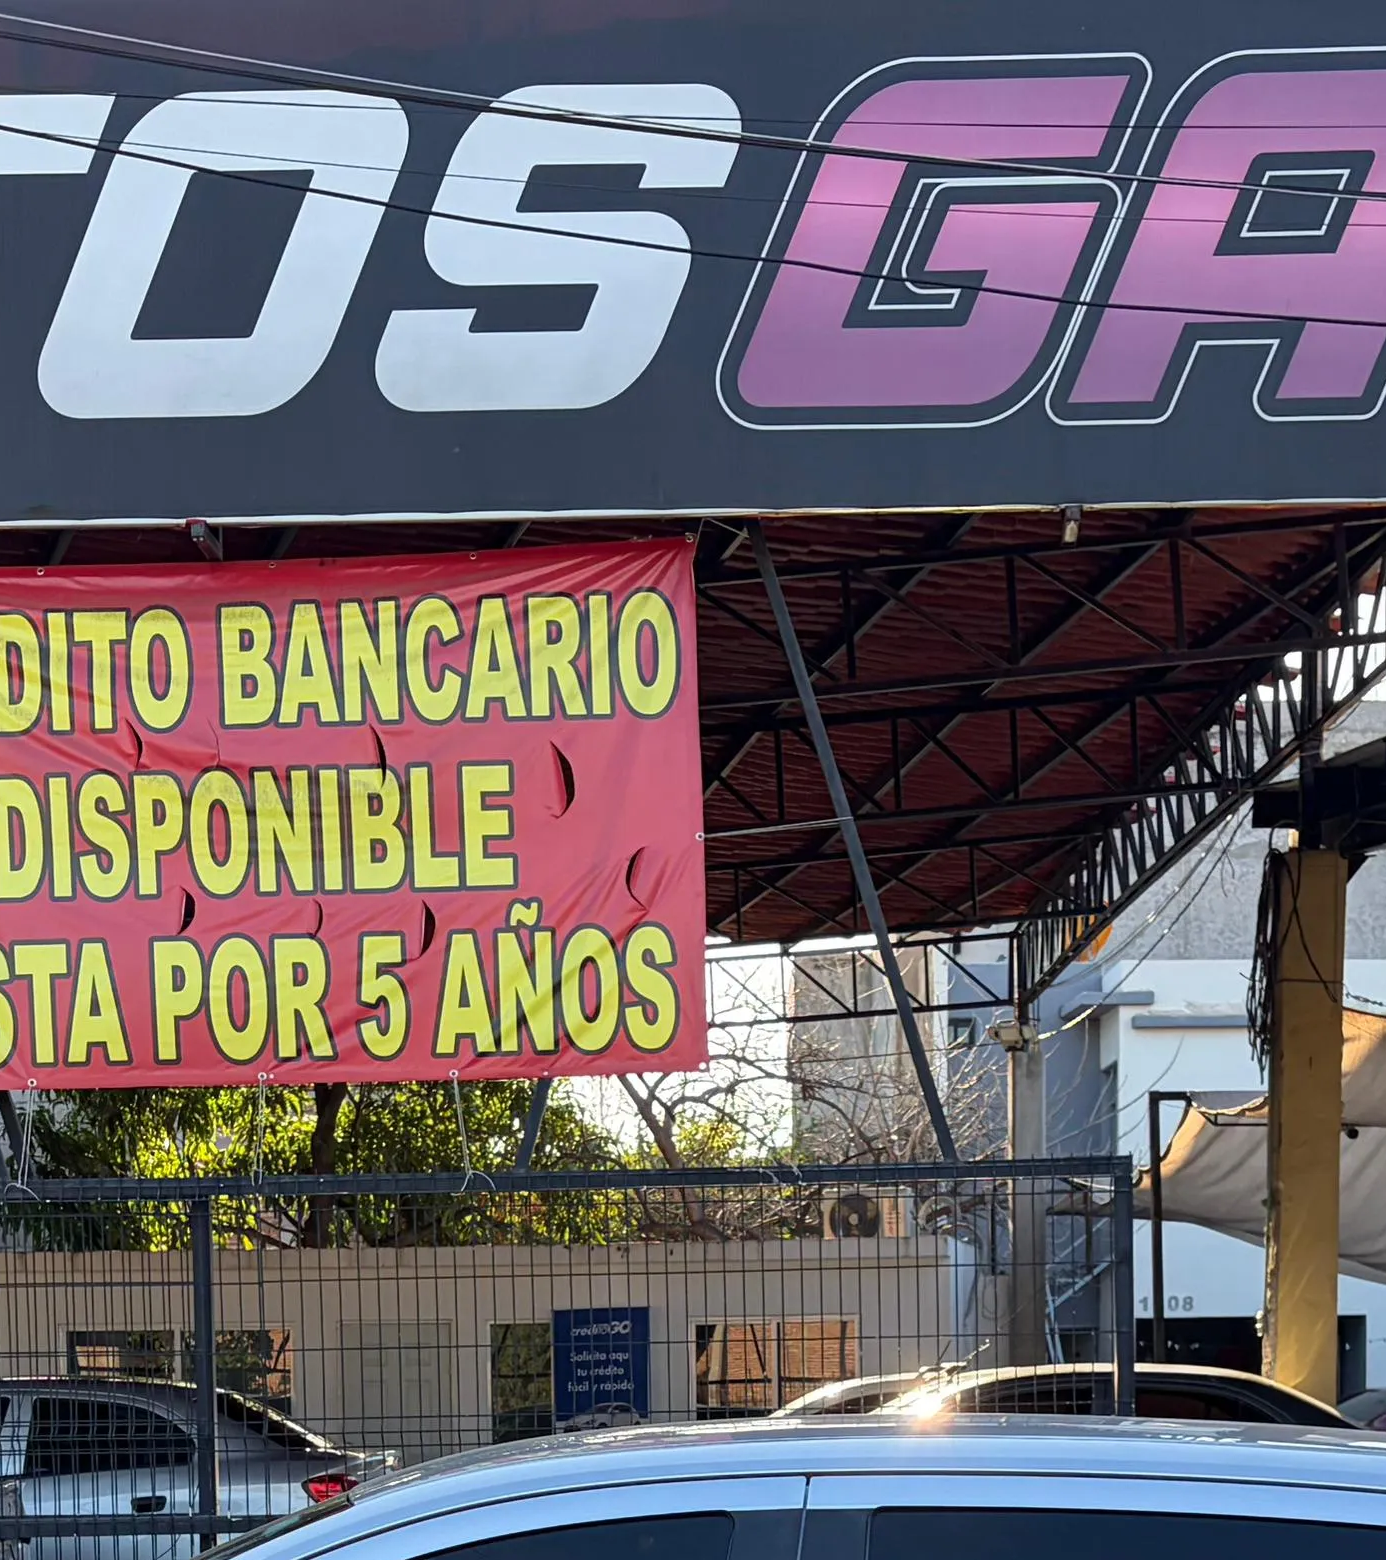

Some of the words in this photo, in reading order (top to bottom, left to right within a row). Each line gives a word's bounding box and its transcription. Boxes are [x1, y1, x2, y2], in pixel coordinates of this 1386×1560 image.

[218, 586, 680, 730] BANCARIO
[150, 932, 338, 1065] POR
[357, 930, 410, 1060] 5
[435, 897, 679, 1060] AÑOS
[1138, 1296, 1194, 1312] 108
